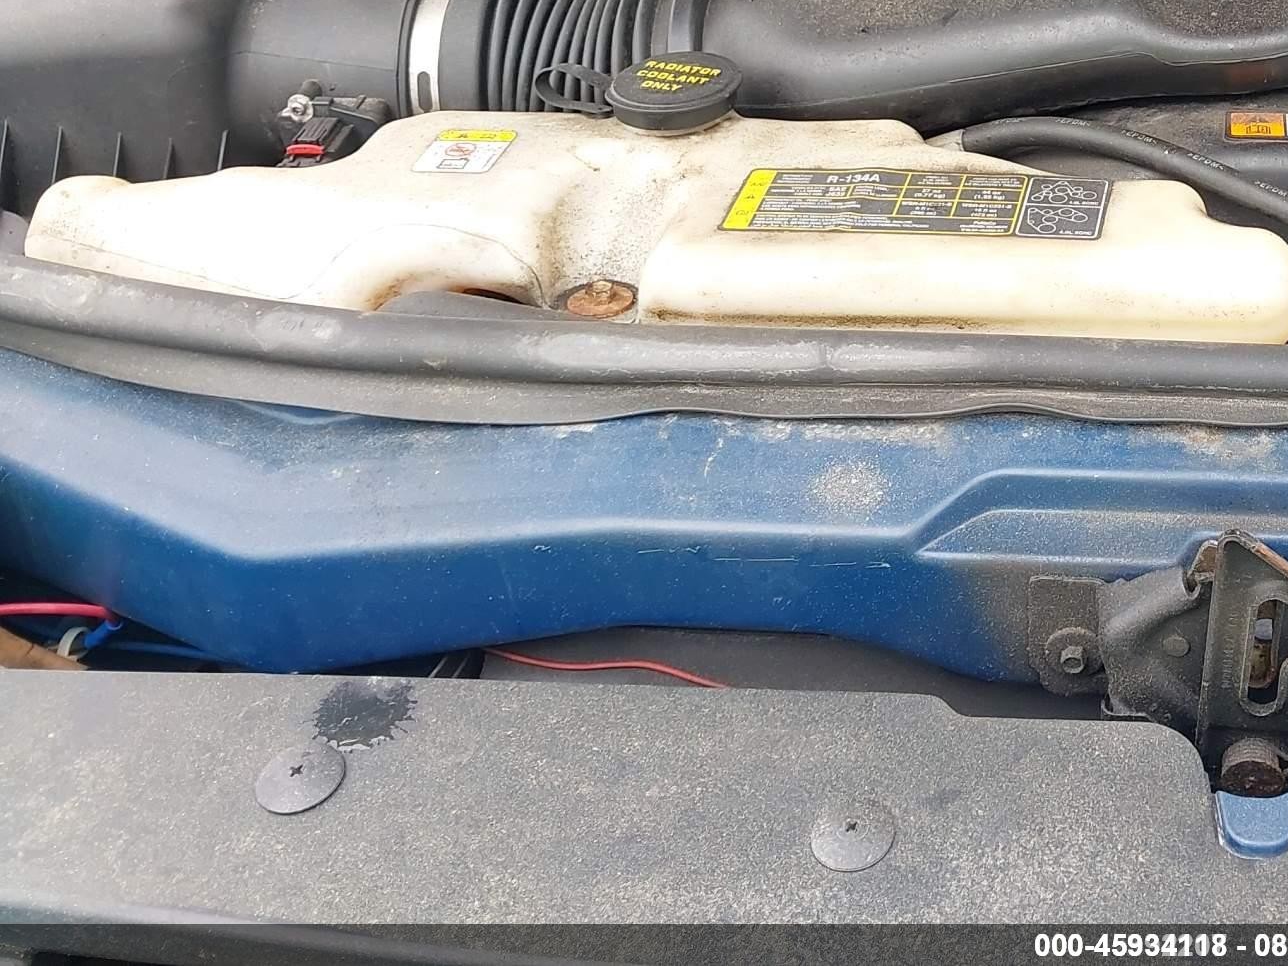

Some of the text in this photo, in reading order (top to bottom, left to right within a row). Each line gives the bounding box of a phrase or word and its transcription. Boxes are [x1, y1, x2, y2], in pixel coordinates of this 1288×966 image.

[645, 60, 722, 77] RADIATOR
[636, 69, 711, 85] COOLANT
[640, 80, 683, 92] ONLY
[826, 173, 881, 184] R-134A
